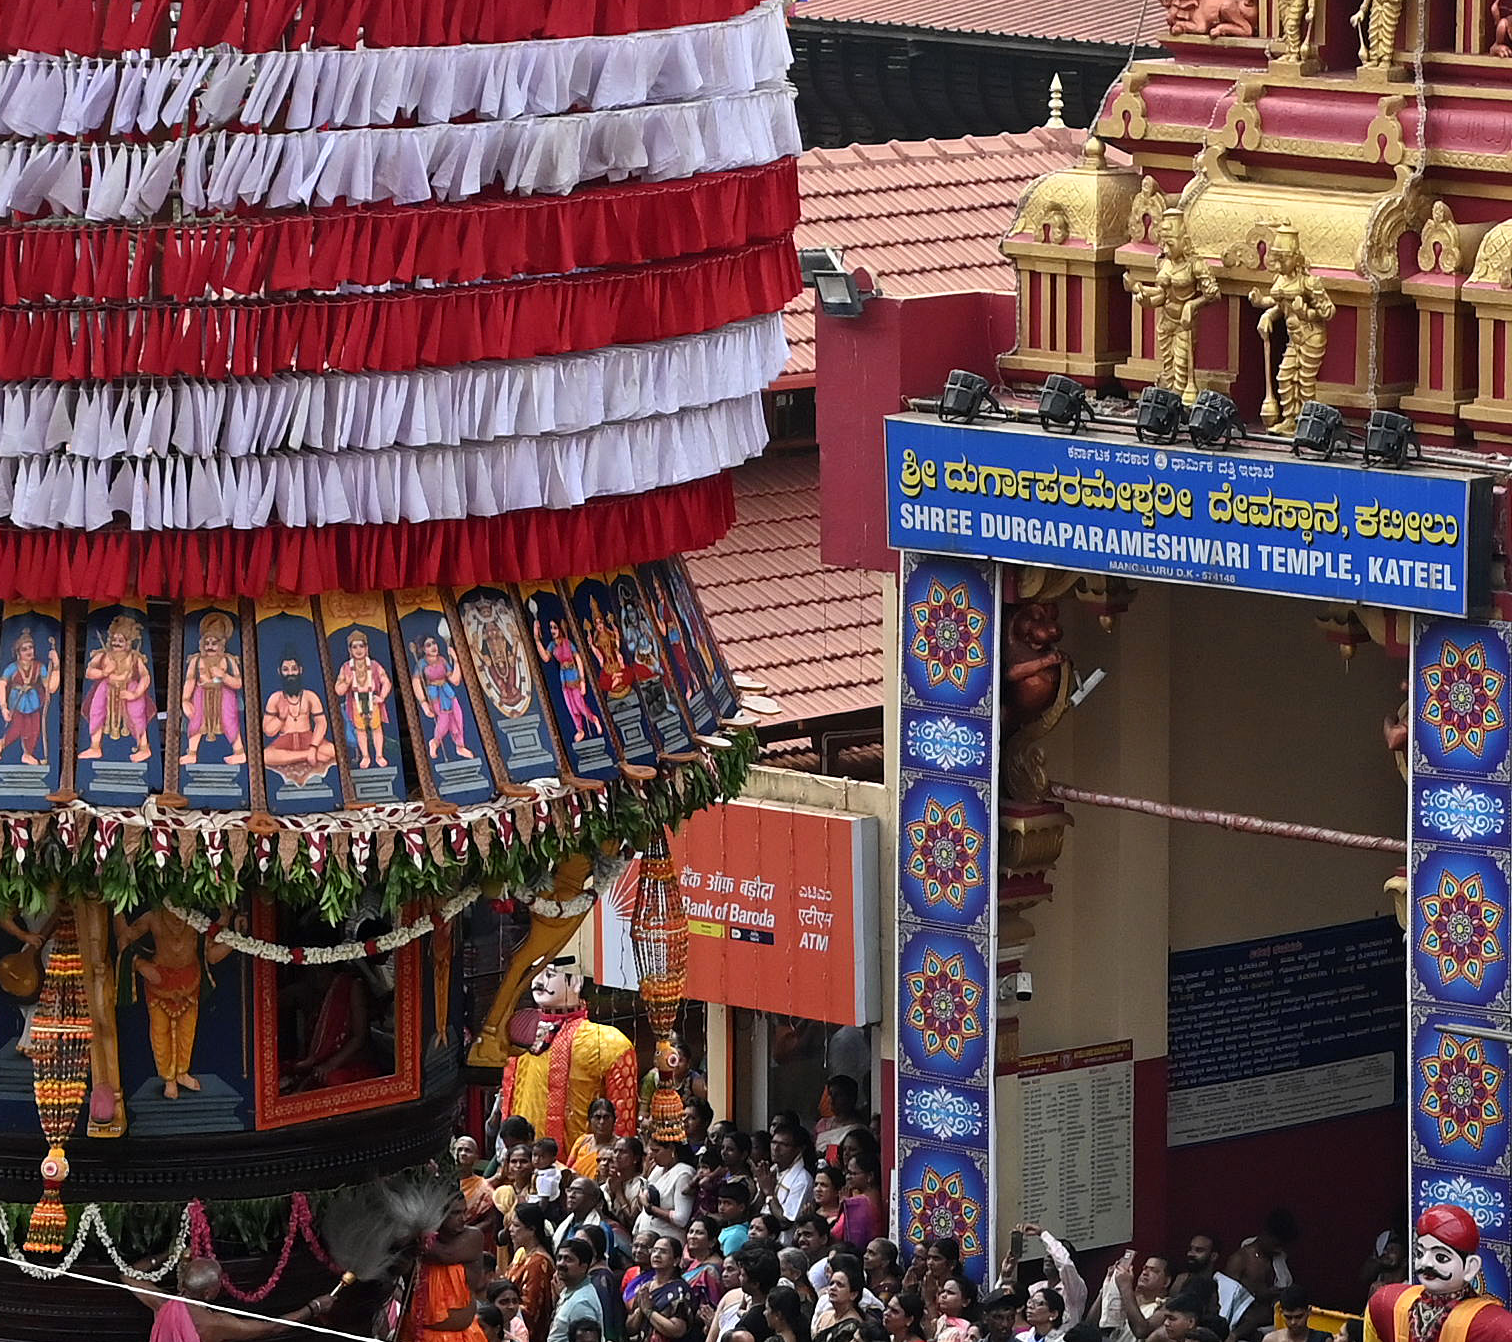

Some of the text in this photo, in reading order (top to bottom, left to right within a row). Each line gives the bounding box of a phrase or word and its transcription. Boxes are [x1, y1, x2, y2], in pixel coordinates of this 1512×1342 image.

[899, 449, 936, 497] ಶ್ರೀ
[1354, 497, 1459, 544] ಕಟೀಲು
[900, 503, 1457, 592] SHREE DURGAPARAMESHWARI TEMPLE, KATEEL
[1109, 561, 1174, 577] MANGALURU
[680, 865, 702, 889] बैंक
[681, 896, 775, 928] Bank of Baroda
[798, 905, 835, 929] एटीएम
[799, 931, 829, 953] ATM
